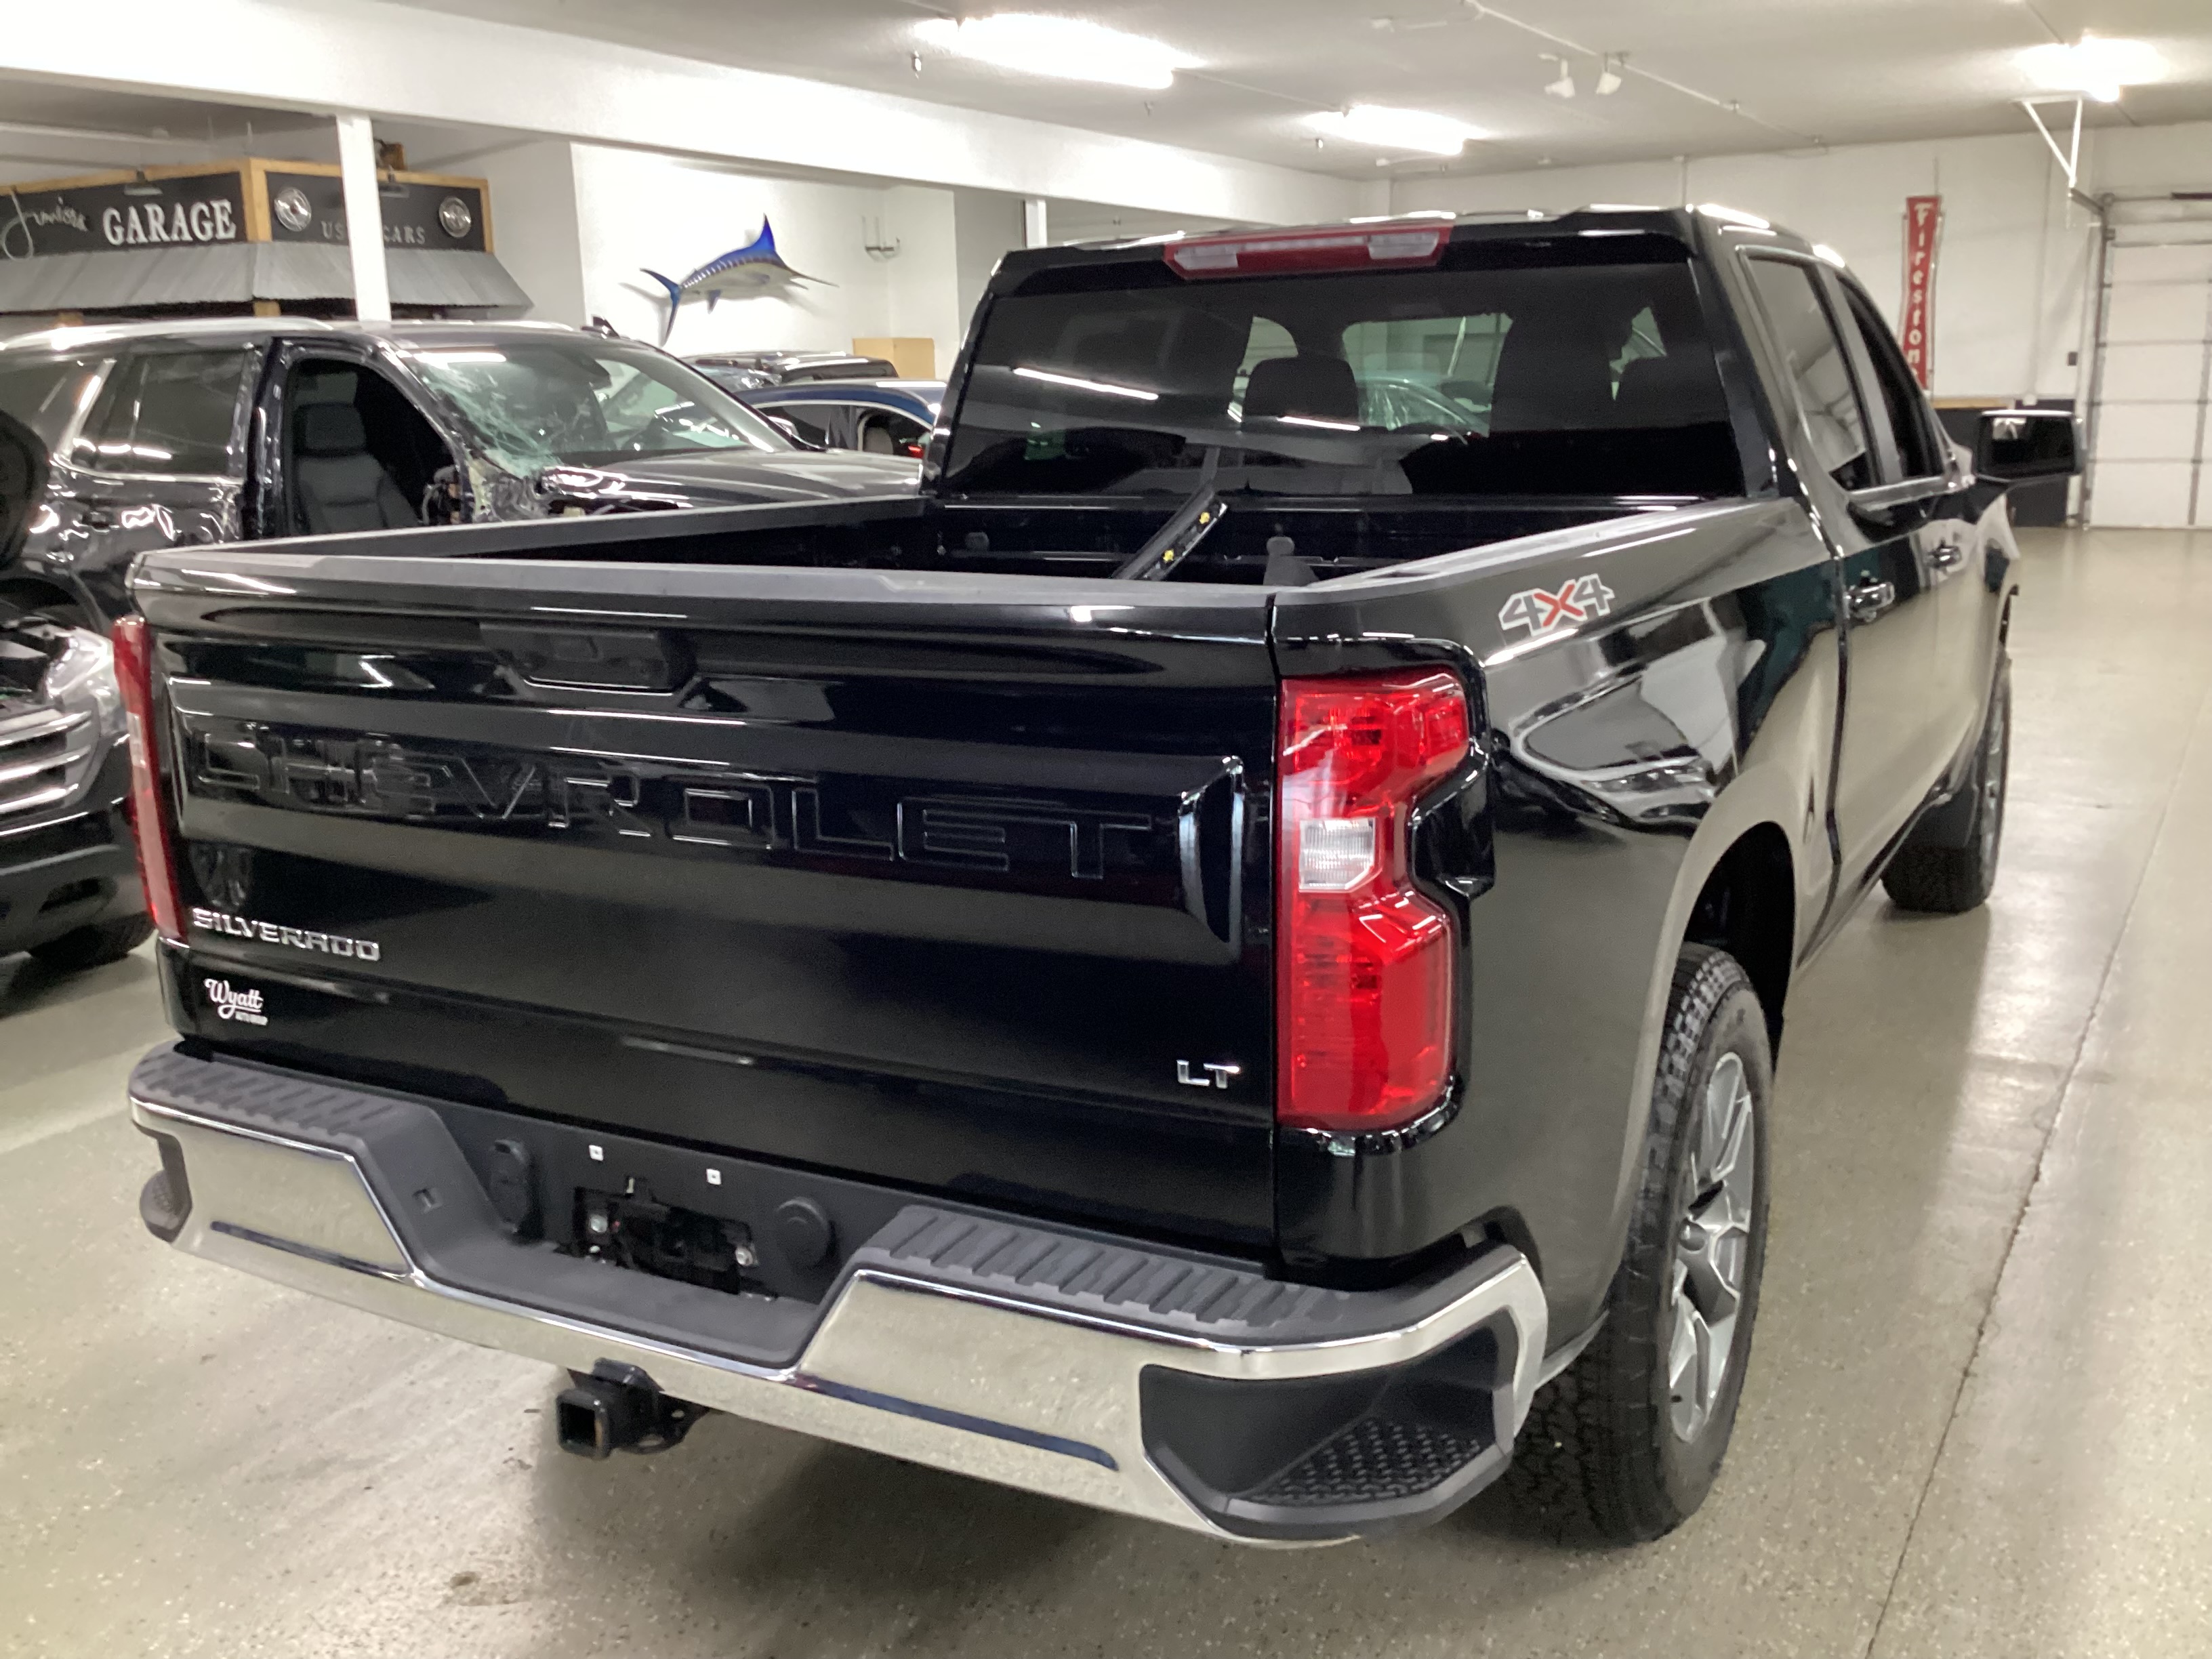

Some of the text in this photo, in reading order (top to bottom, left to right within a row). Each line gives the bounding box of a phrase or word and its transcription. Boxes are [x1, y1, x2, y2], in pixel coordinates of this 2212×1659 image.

[102, 199, 237, 245] GARAGE
[382, 225, 426, 245] CARS
[190, 729, 1153, 880] CHEVROLET
[192, 907, 381, 962] SILVERADO
[204, 978, 264, 1019] Wyatt
[1176, 1059, 1240, 1089] LT
